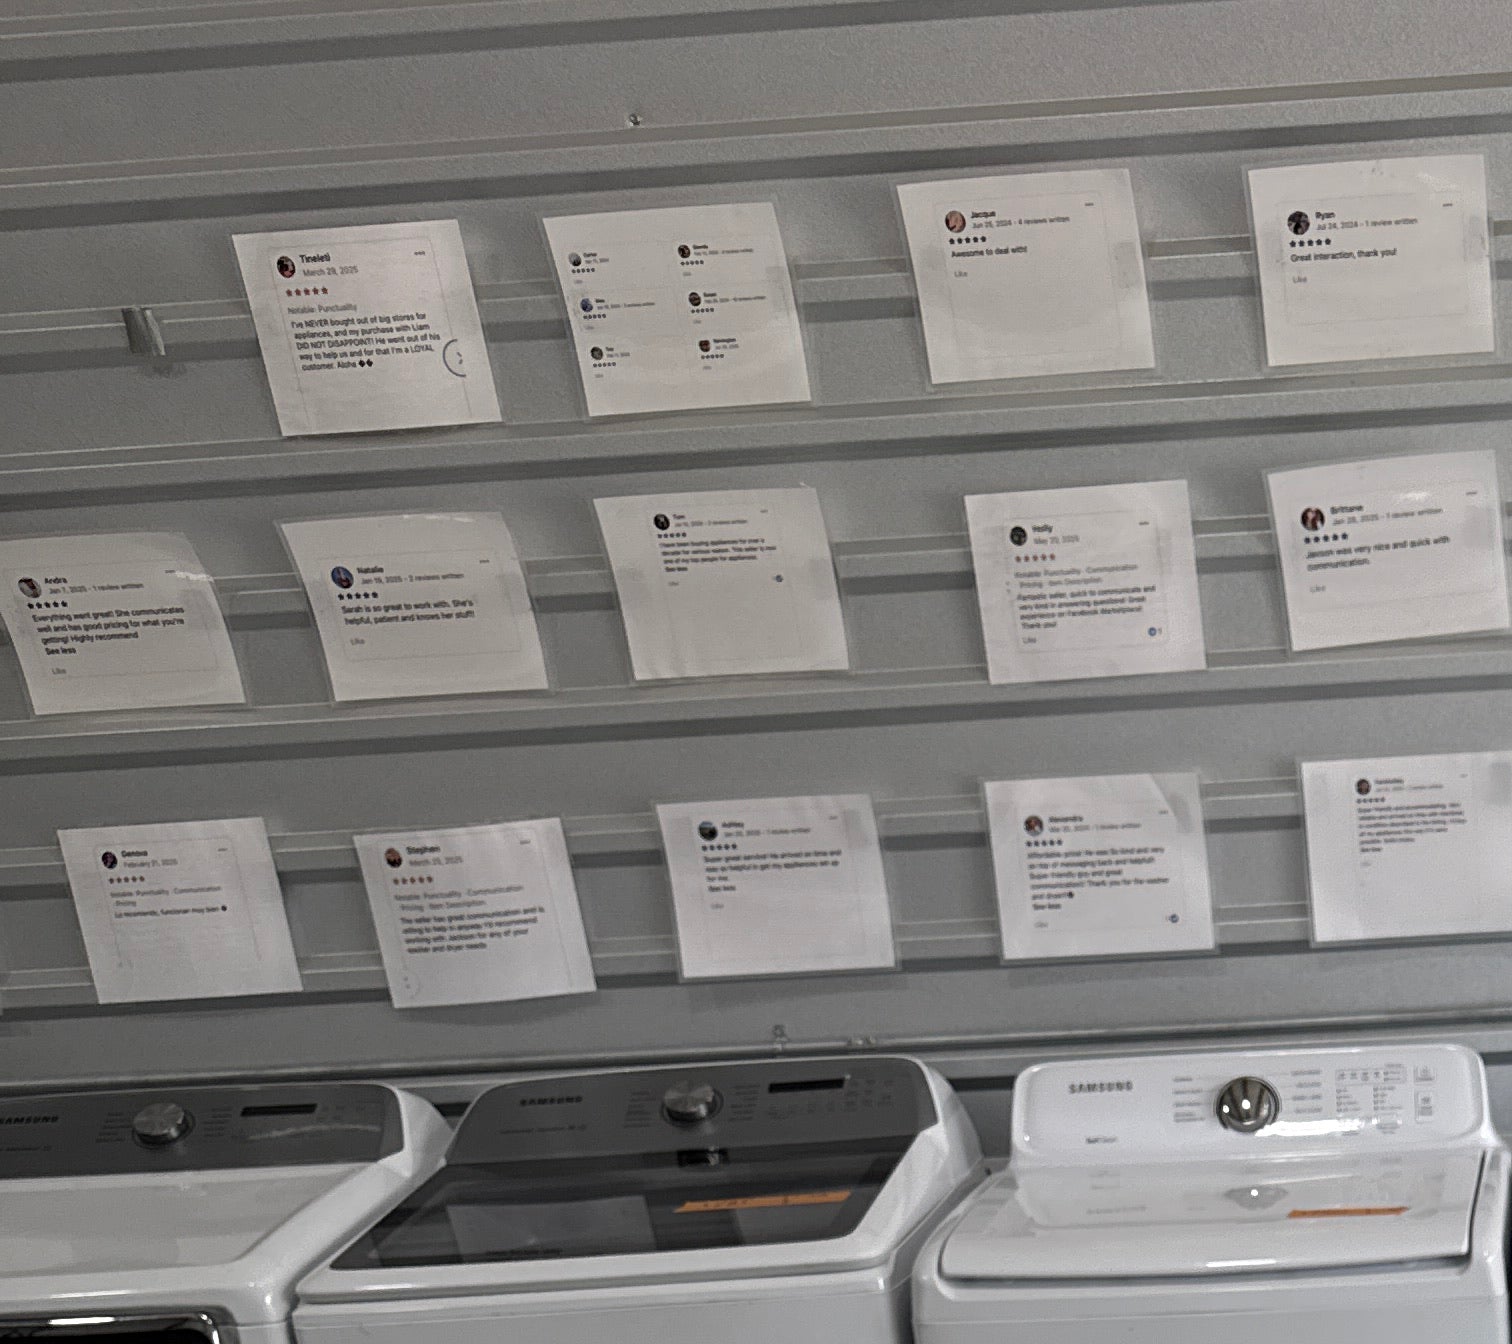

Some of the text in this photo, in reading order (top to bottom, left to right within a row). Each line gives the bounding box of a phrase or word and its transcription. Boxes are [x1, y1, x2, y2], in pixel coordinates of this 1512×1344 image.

[1315, 211, 1335, 220] Ryan
[951, 248, 984, 259] Awesome
[985, 248, 993, 257] to
[995, 247, 1009, 255] deal
[1290, 253, 1311, 262] Great
[1357, 249, 1379, 258] thank
[305, 319, 329, 328] NEVER
[330, 318, 355, 328] bought
[356, 316, 369, 325] out
[370, 316, 377, 324] of
[379, 315, 391, 325] big
[392, 314, 415, 322] stores
[415, 312, 426, 320] for
[374, 615, 400, 625] patient
[401, 614, 415, 622] and
[416, 613, 440, 621] knows
[441, 611, 453, 620] her
[70, 634, 94, 643] Highly
[95, 631, 139, 641] recommend
[1069, 1081, 1132, 1094] SAMSUNG
